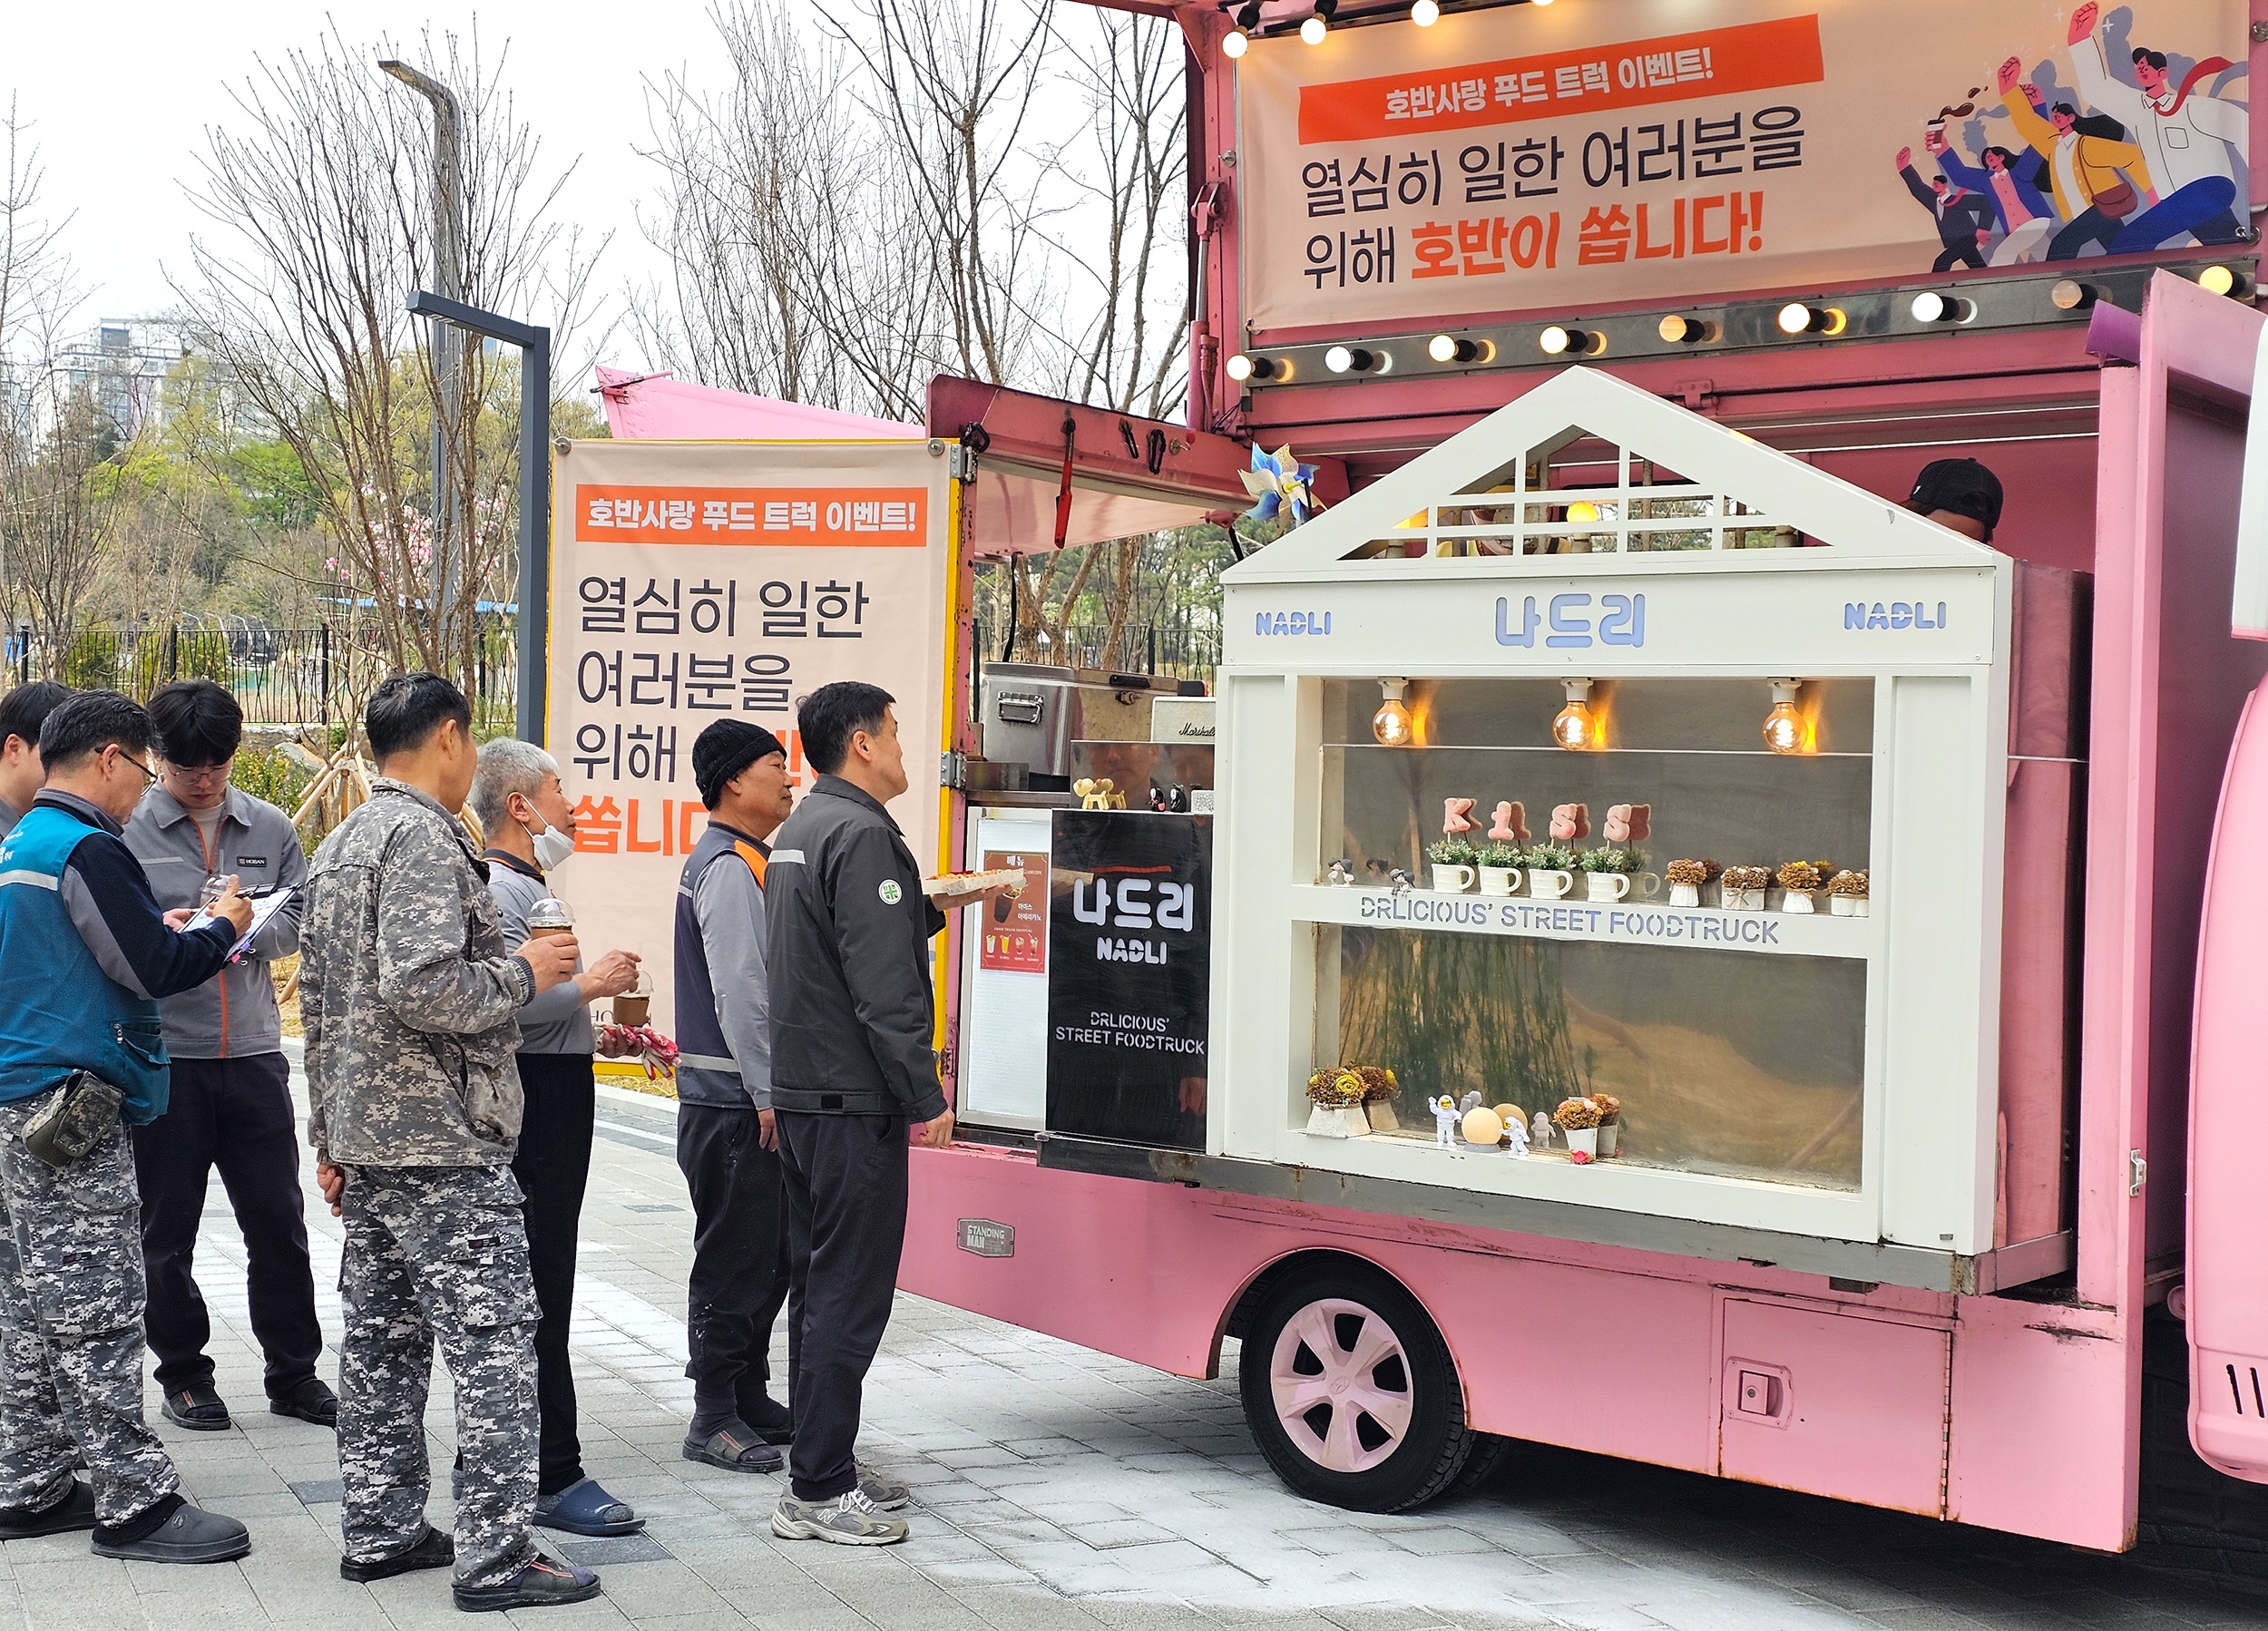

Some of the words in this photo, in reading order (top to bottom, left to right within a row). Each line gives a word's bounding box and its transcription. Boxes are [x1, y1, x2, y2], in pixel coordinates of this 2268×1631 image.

[1383, 77, 1488, 120] 호반사랑
[1493, 71, 1549, 107] 푸드
[1554, 61, 1611, 94] 트럭
[1618, 46, 1715, 89] 이벤트!
[1302, 148, 1442, 219] 열심히
[1458, 136, 1567, 203] 일한
[1582, 104, 1806, 190] 여러분을
[1303, 225, 1395, 290] 위해
[1411, 210, 1559, 279] 호반이
[1578, 190, 1765, 267] 쏩니다!
[587, 498, 695, 530] 호반사랑
[701, 500, 756, 532] 푸드
[763, 501, 817, 532] 트럭
[826, 502, 917, 532] 이벤트!
[579, 576, 737, 637] 열심히
[758, 580, 870, 639] 일한
[1256, 610, 1333, 637] NADLI
[1494, 592, 1647, 649] 나드리
[1843, 601, 1947, 631] NADLI
[577, 649, 793, 712] 여러분을
[572, 723, 677, 783] 위해
[1073, 877, 1194, 933] 나드리
[1501, 905, 1602, 933] STREET
[1609, 911, 1779, 944] FOODTRUCK
[1097, 937, 1167, 965] NADLI
[1055, 1026, 1112, 1045] STREET
[1115, 1031, 1206, 1055] FOODTRUCK
[966, 1235, 985, 1249] MAN
[967, 1225, 1005, 1239] STANDING
